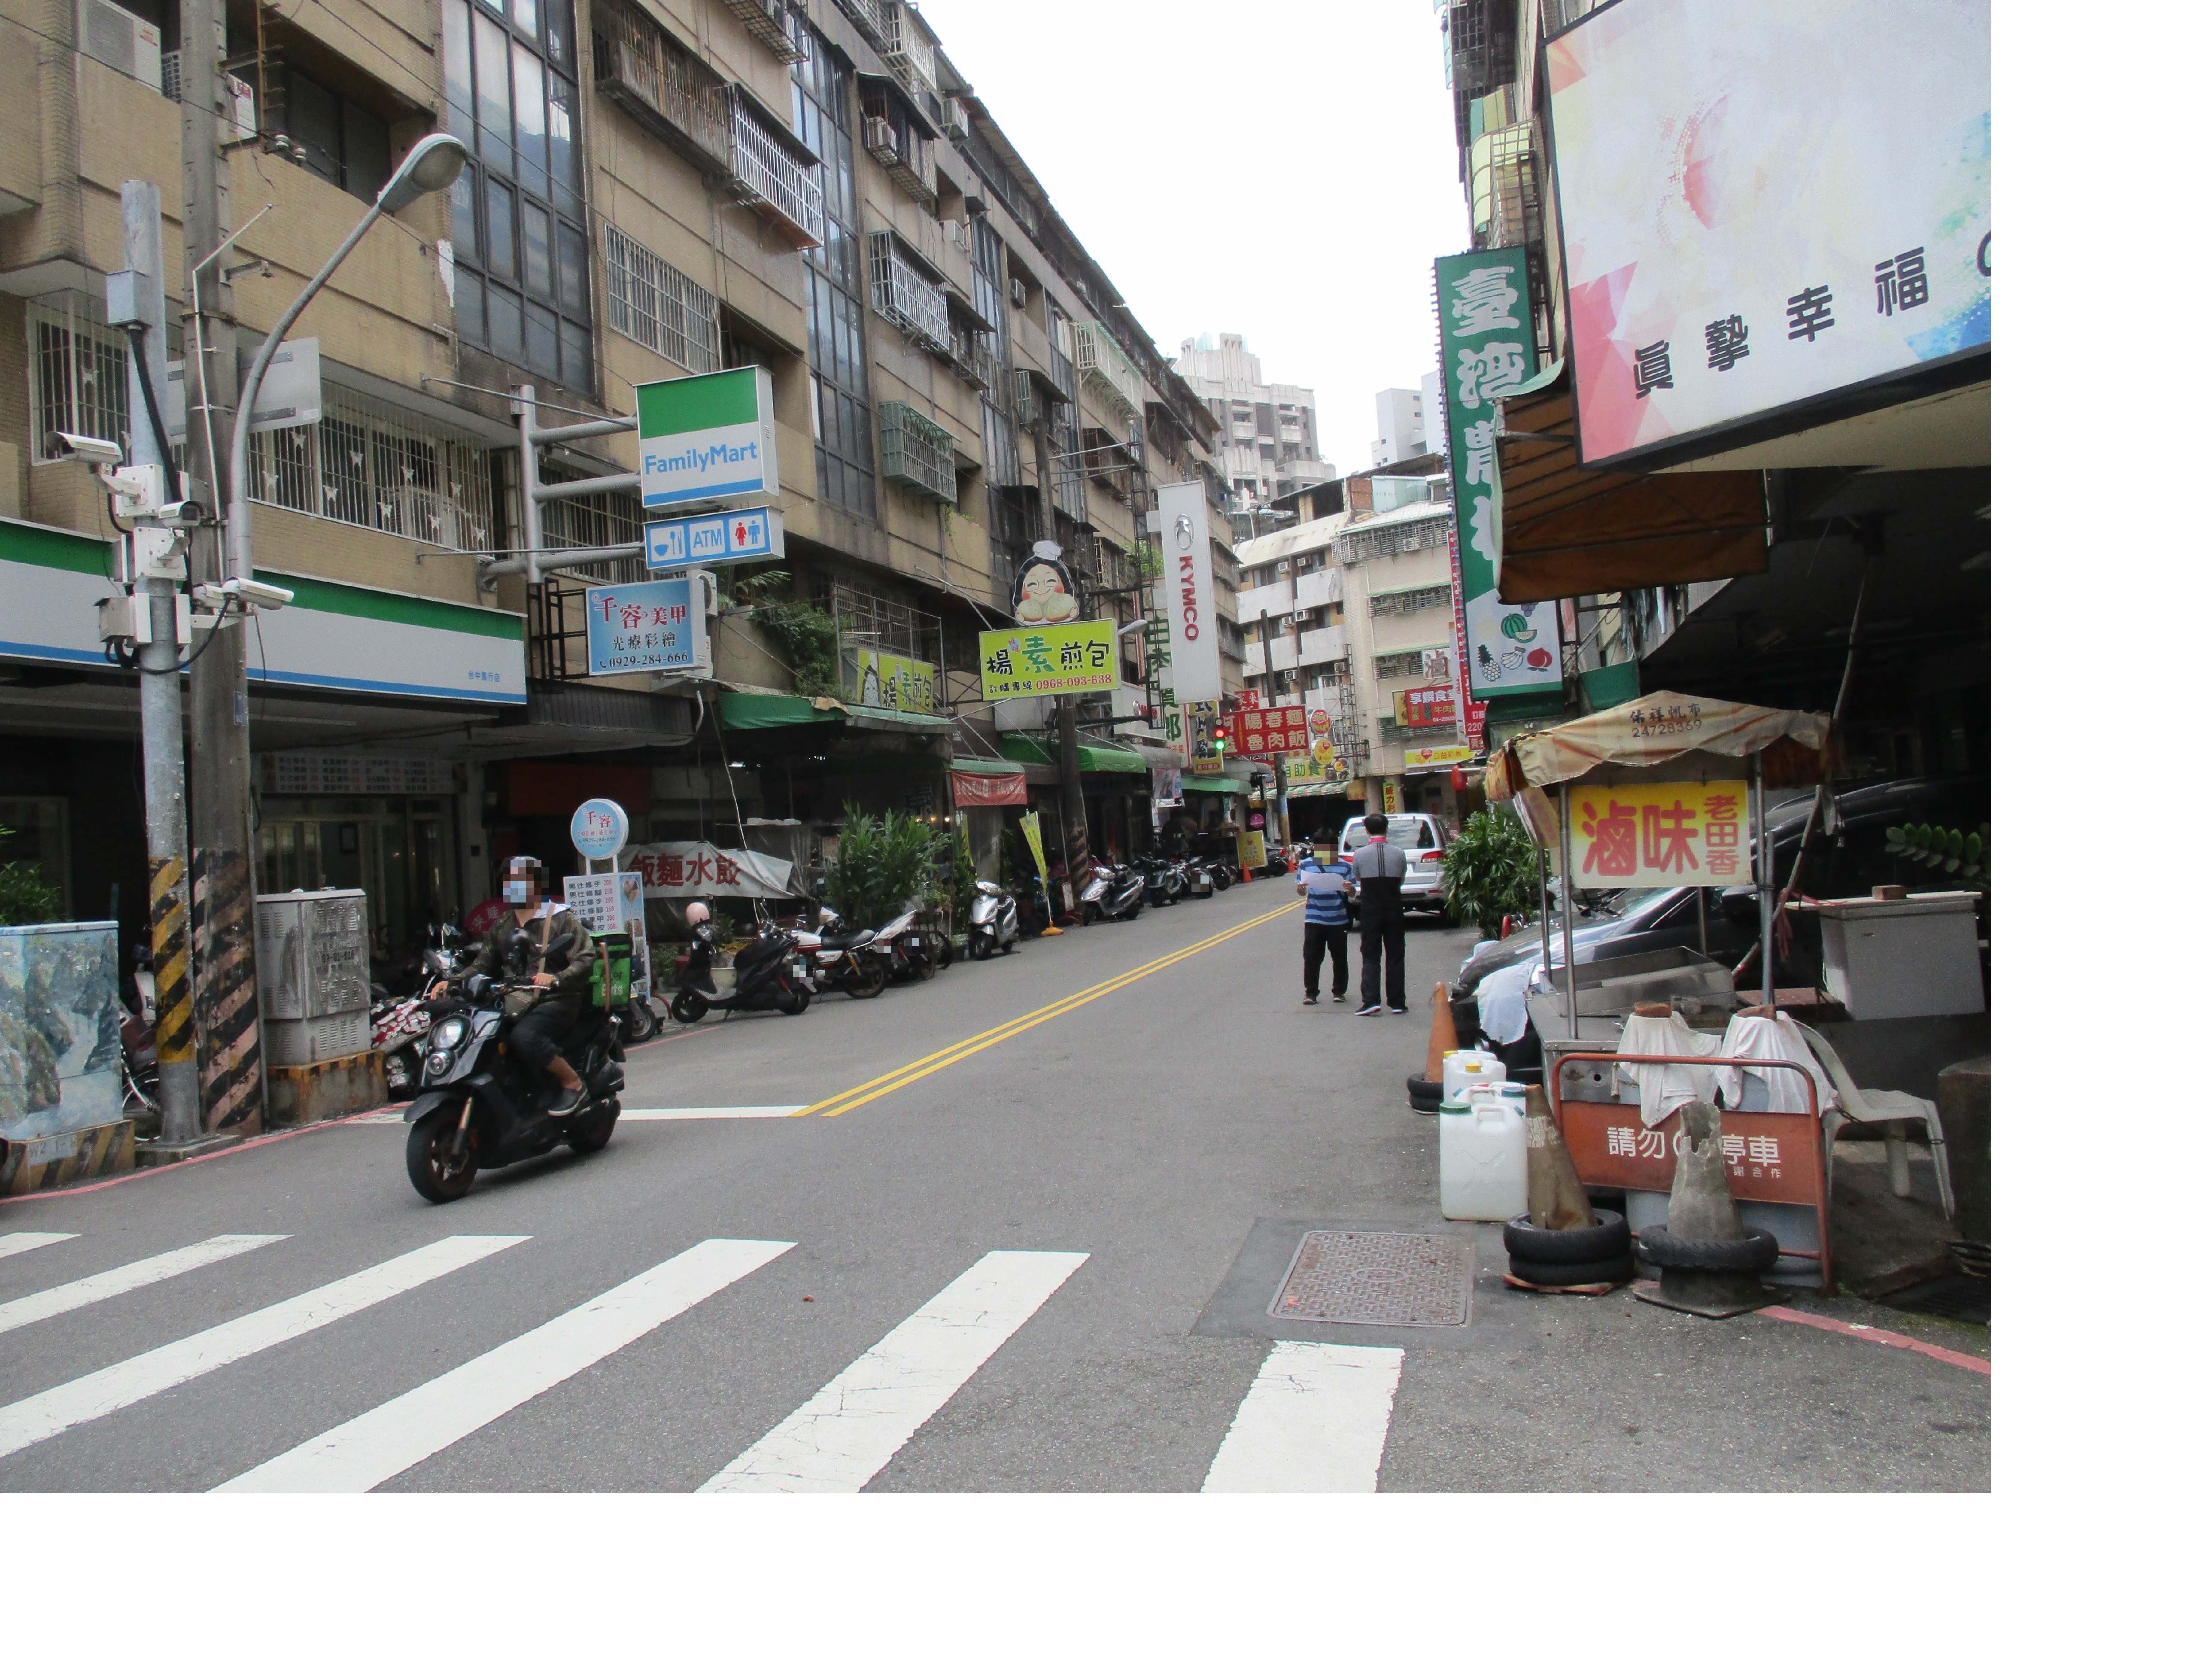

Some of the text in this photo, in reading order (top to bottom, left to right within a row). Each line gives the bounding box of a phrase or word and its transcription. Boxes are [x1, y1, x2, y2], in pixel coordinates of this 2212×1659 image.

[644, 441, 758, 475] FamilyMart
[693, 527, 722, 549] ATM
[1179, 555, 1200, 641] KYMCO
[594, 596, 687, 629] 千容美甲
[611, 631, 675, 651] 光療彩繪
[609, 651, 688, 668] 0929-284-666
[989, 673, 1112, 693] 訂購專線 0968-093-638
[1245, 709, 1304, 730] 陽春麵
[1467, 721, 1484, 732] 220
[1632, 719, 1702, 738] 24728369
[1247, 730, 1306, 750] 魯肉飯
[584, 811, 611, 828] 千容
[1582, 799, 1699, 876] 滷味
[1703, 794, 1740, 875] 老田香
[569, 880, 601, 890] 男仕修手
[1607, 1127, 1665, 1159] 請勿
